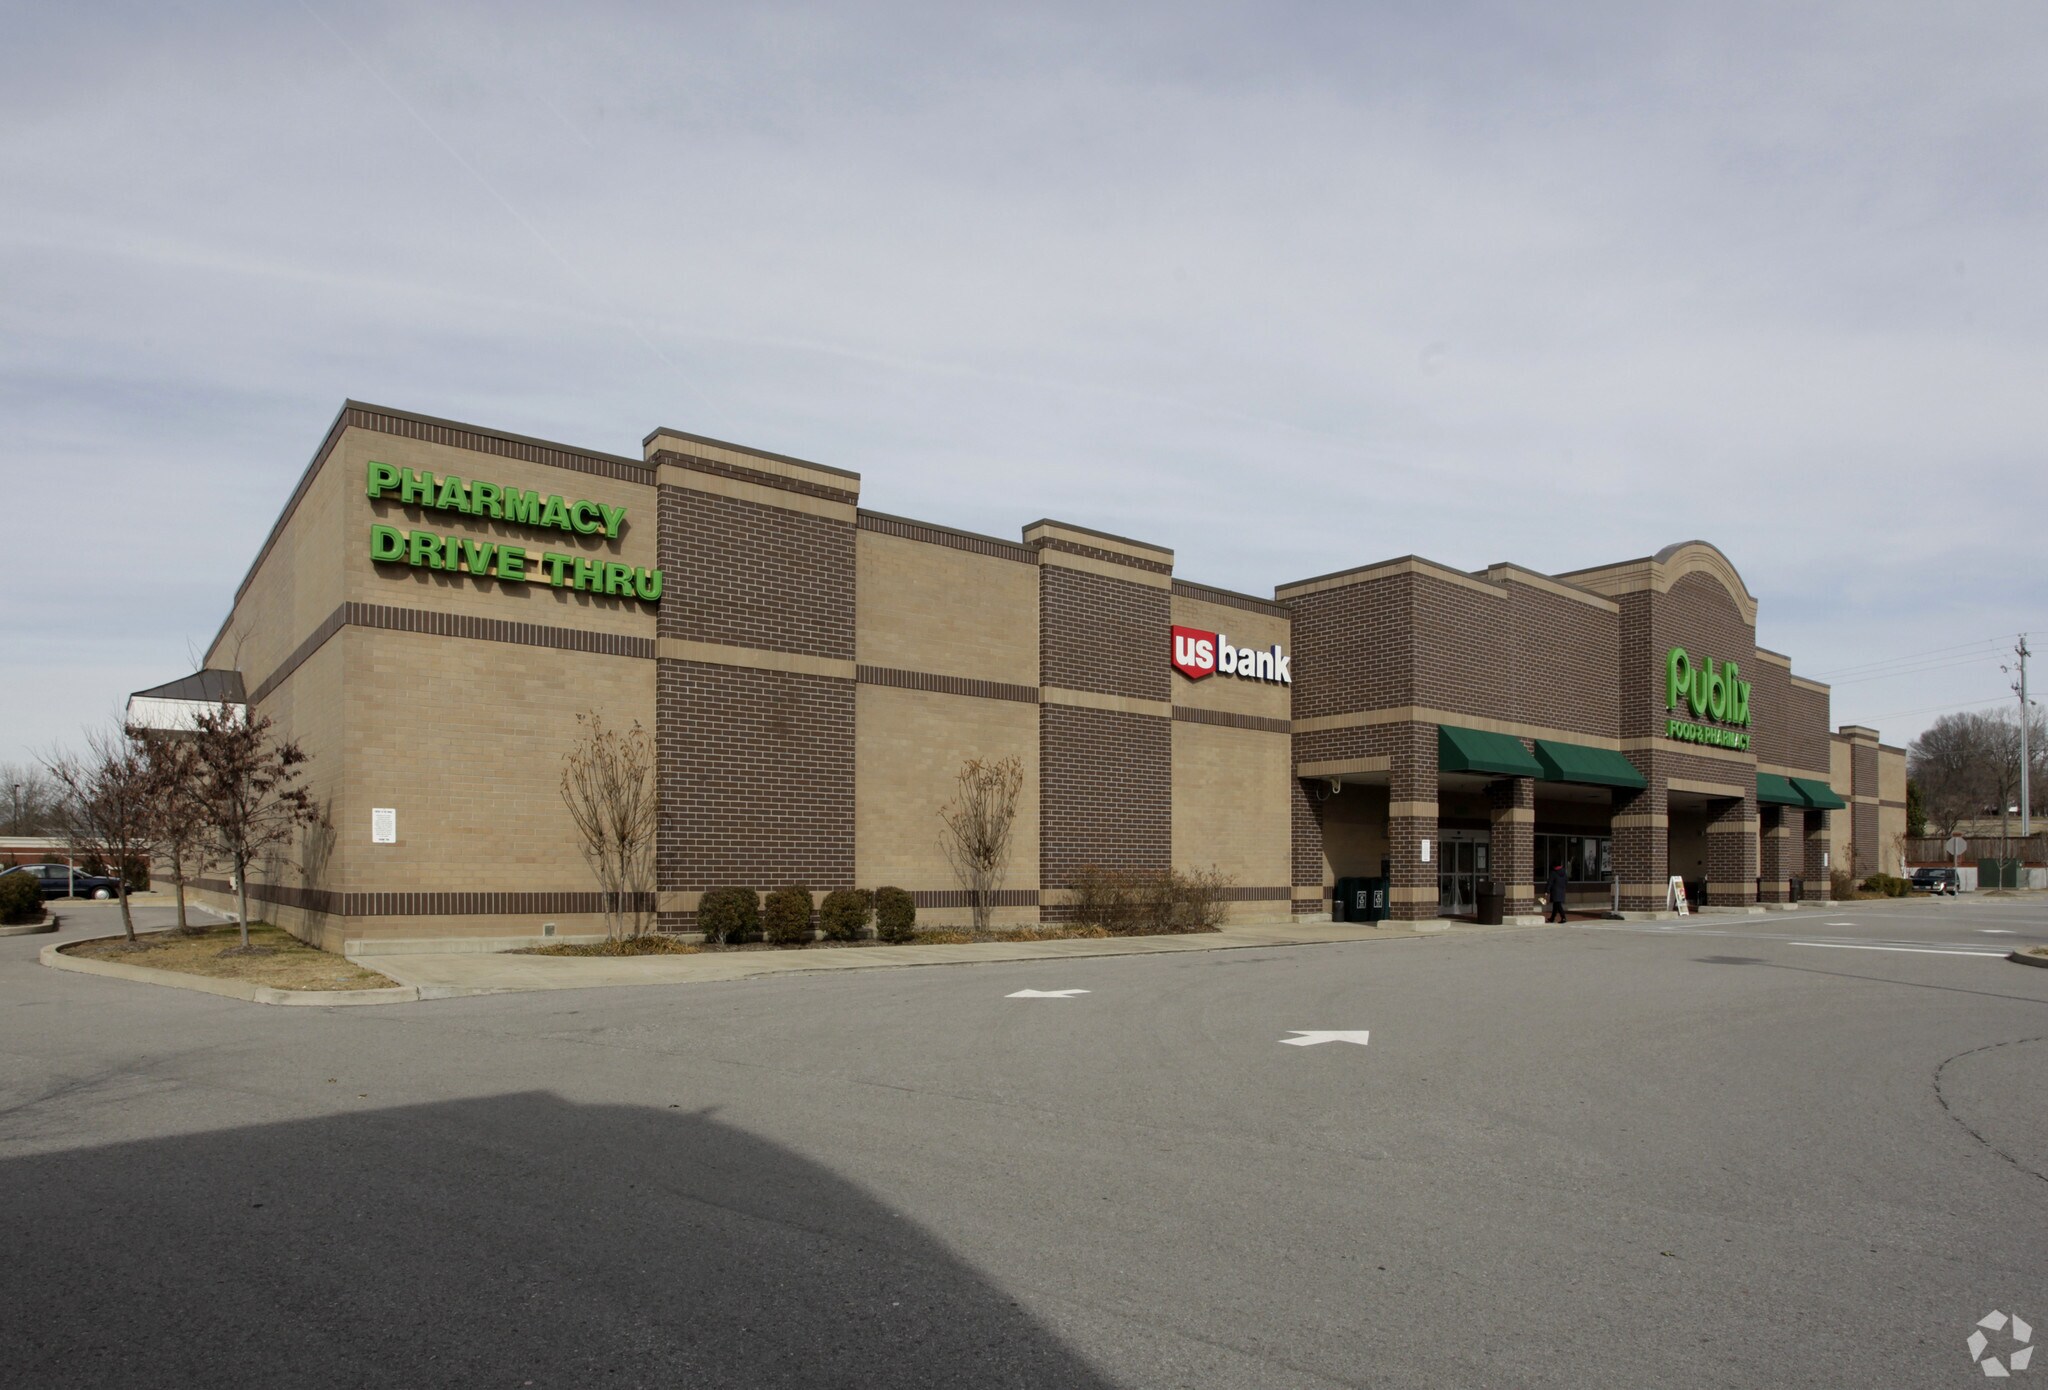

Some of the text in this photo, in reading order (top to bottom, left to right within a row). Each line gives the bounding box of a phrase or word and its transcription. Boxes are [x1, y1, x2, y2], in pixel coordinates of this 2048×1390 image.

[368, 461, 627, 539] PHARMACY
[370, 524, 663, 600] DRIVE THRU
[1175, 633, 1292, 683] us bank
[1666, 646, 1752, 726] Publix
[1667, 719, 1696, 740] FOOD
[1704, 726, 1751, 750] PHARMACY
